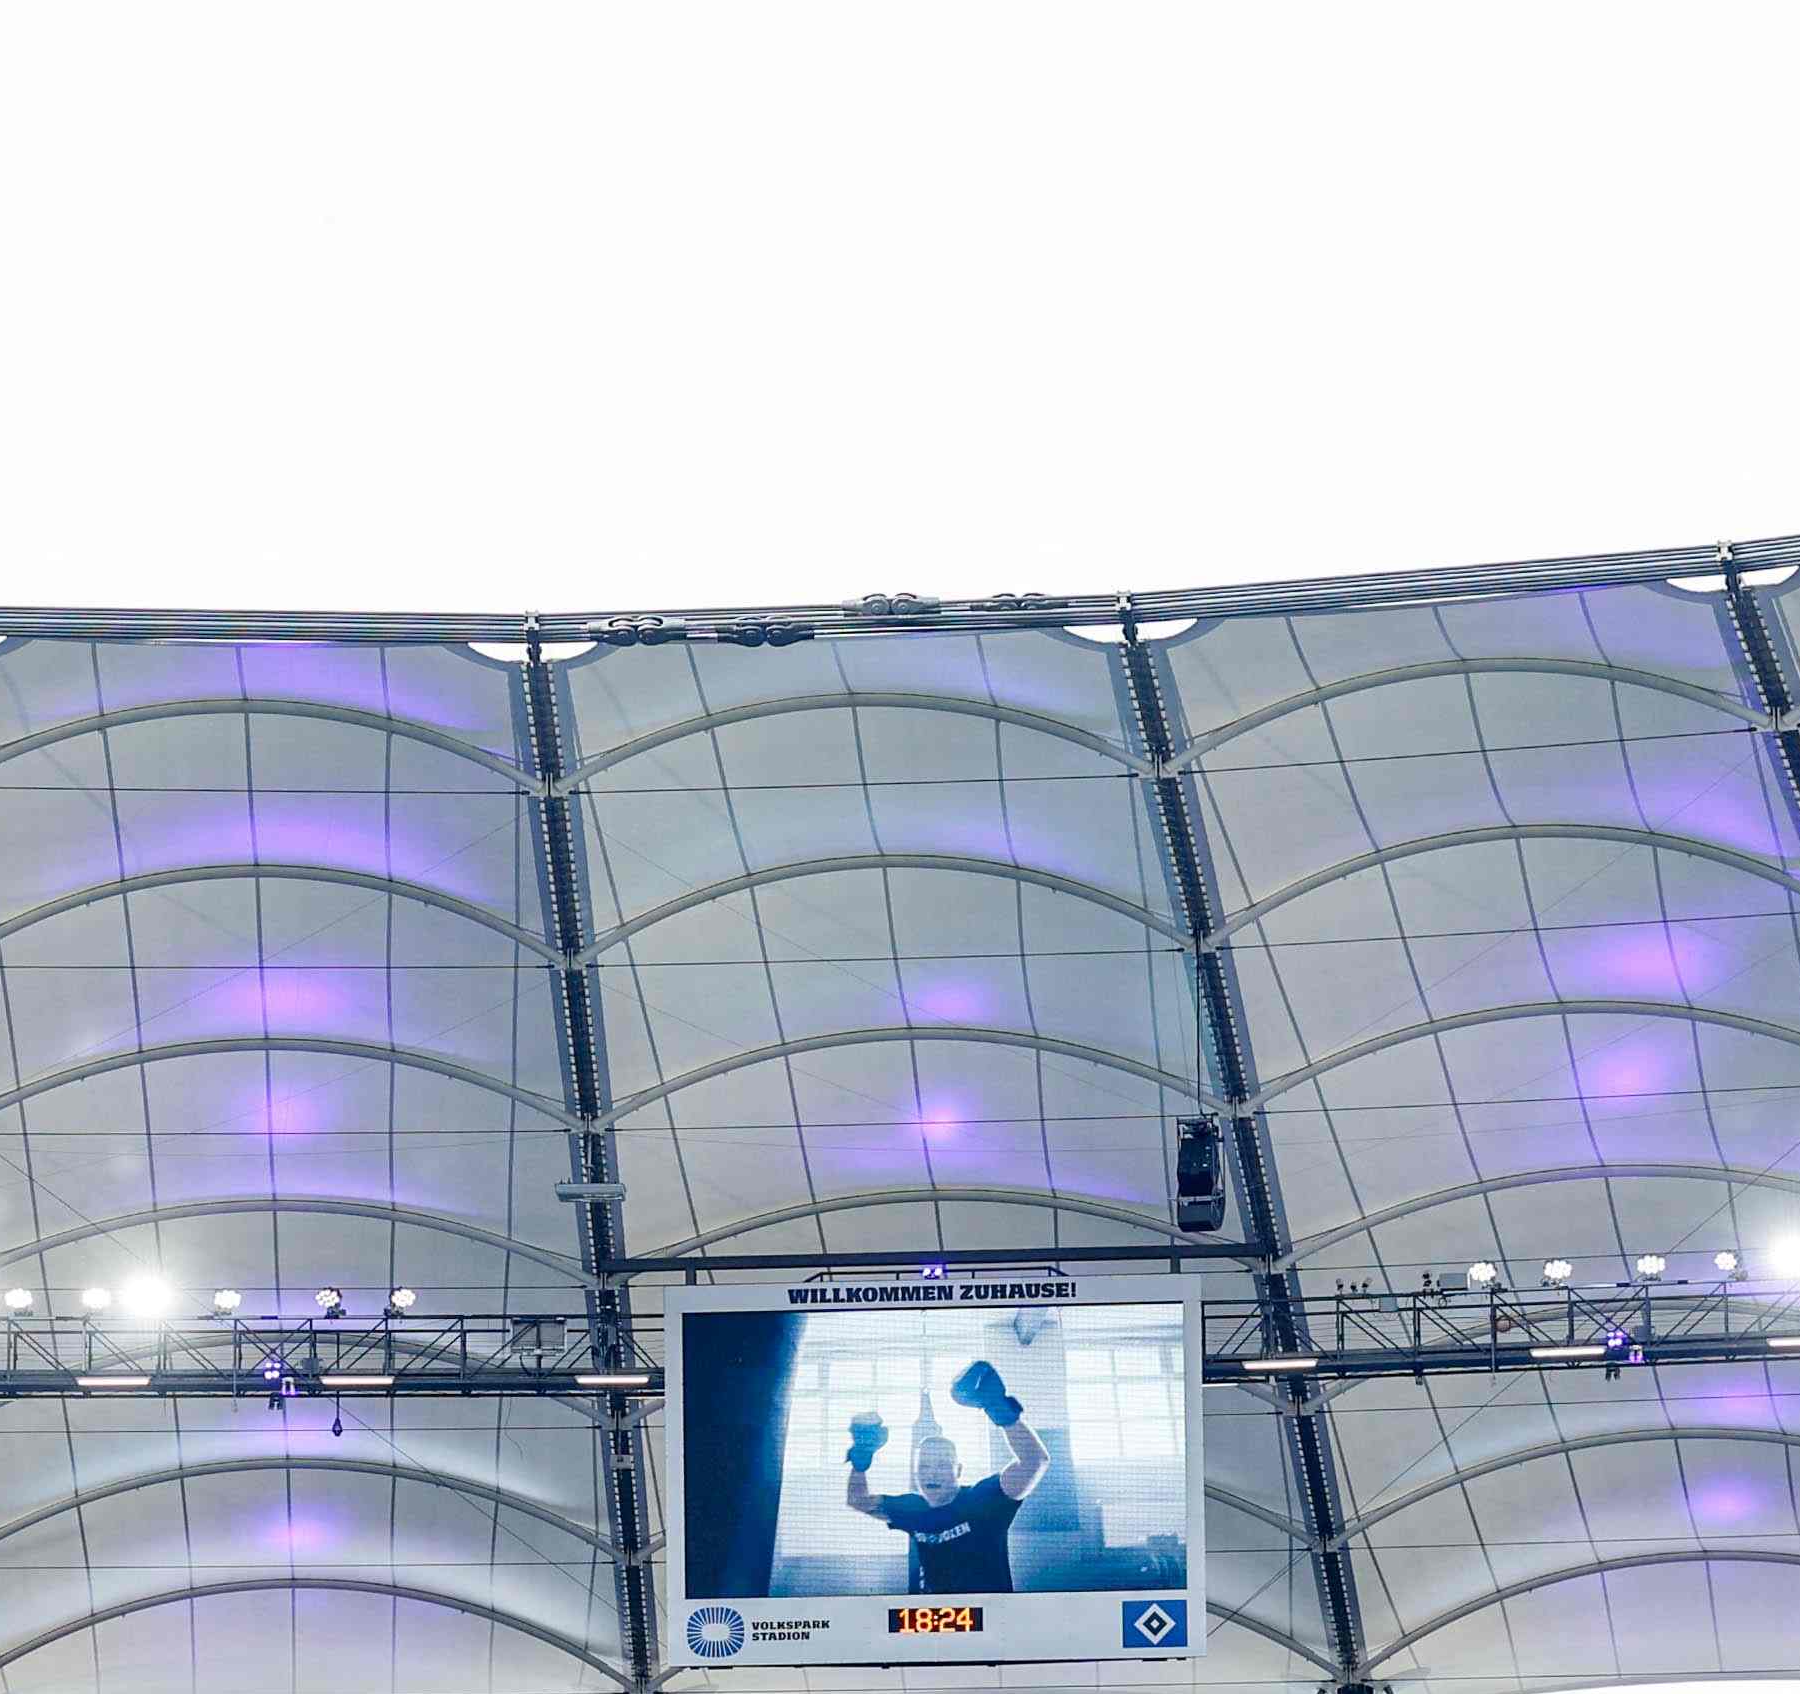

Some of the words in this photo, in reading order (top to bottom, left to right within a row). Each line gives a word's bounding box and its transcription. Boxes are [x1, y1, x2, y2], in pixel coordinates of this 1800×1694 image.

[788, 1284, 953, 1304] WILLKOMMEN
[960, 1282, 1076, 1300] ZUHAUSE!
[752, 1619, 830, 1631] VOLKSPARK
[899, 1607, 974, 1633] 18:24
[752, 1632, 810, 1641] STADION
